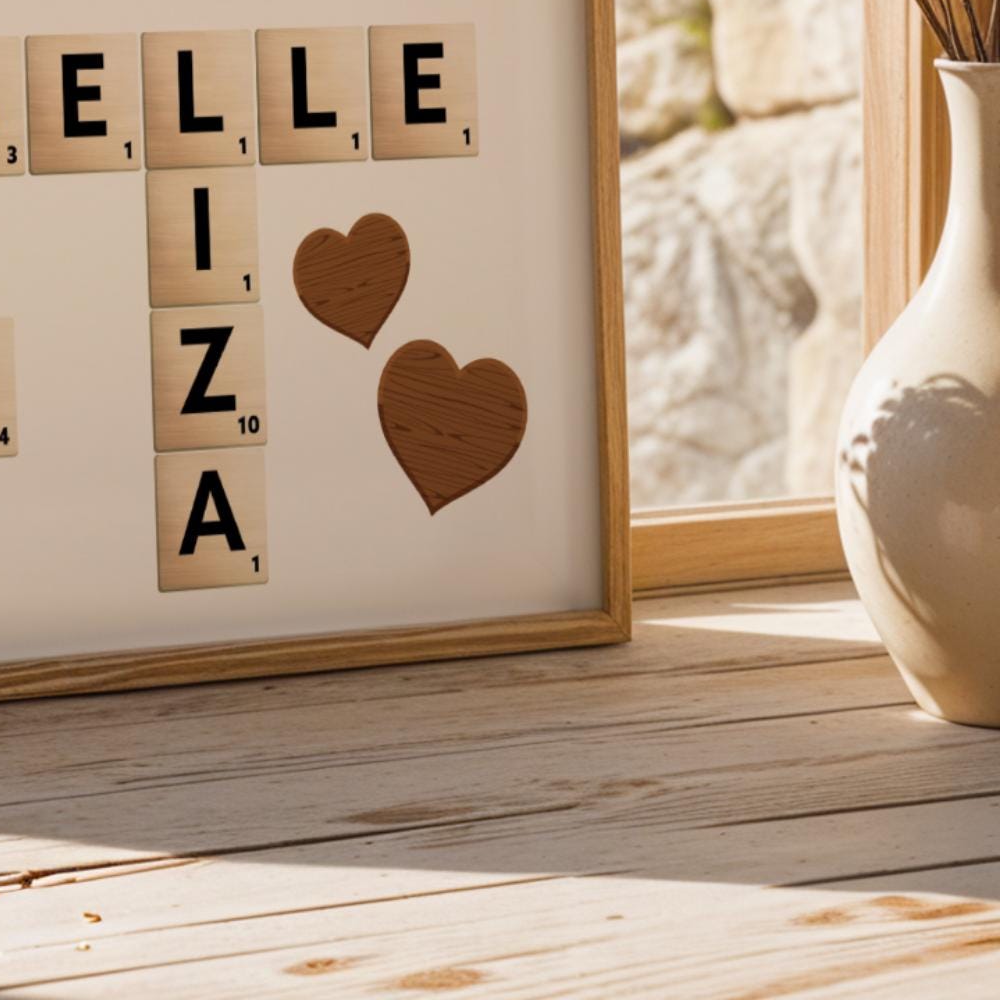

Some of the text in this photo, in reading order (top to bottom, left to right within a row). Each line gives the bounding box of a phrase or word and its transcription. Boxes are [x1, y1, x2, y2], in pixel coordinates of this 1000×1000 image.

[352, 133, 359, 150] 1
[463, 128, 470, 145] 1
[124, 141, 132, 159] 1
[239, 137, 246, 154] 1
[7, 145, 18, 164] 3
[243, 274, 251, 291] 1
[238, 415, 260, 434] 10
[252, 555, 259, 572] 1
